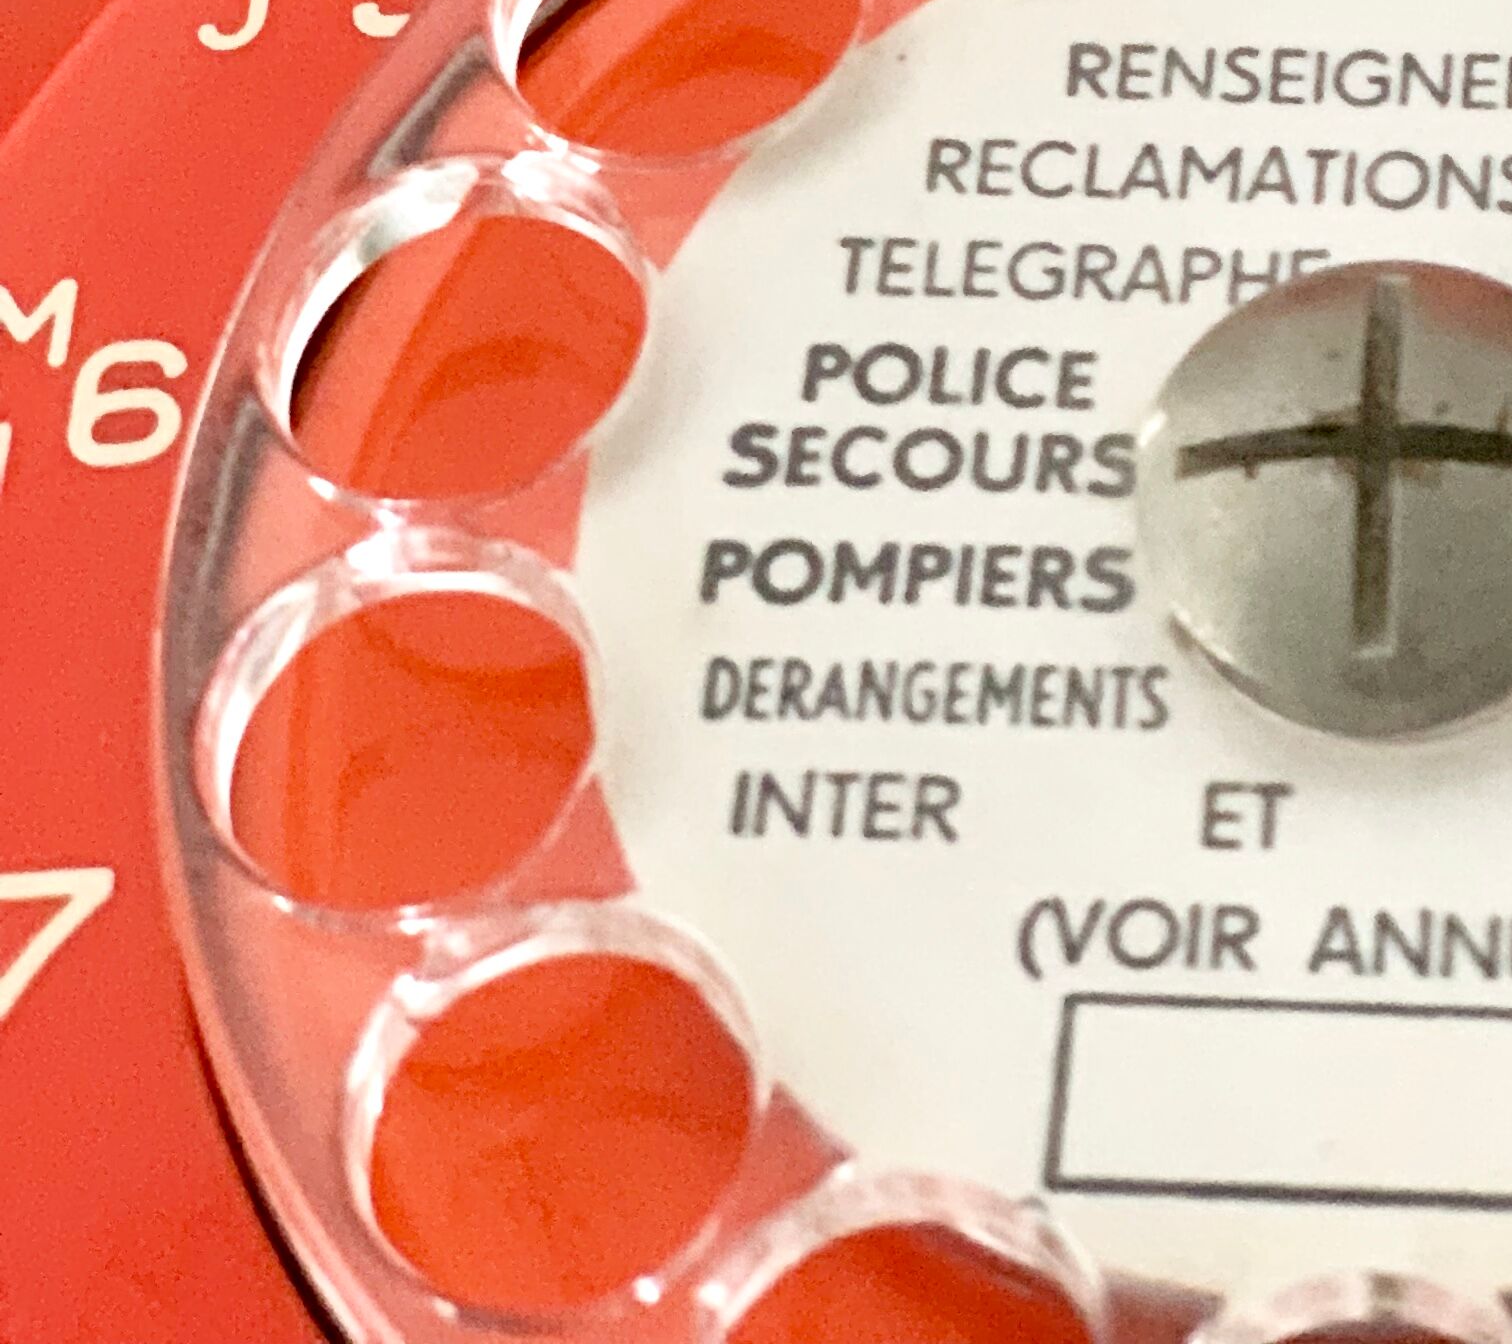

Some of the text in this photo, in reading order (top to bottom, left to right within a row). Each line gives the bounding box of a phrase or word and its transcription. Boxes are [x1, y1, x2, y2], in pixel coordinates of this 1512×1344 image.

[66, 338, 189, 468] 6
[801, 342, 1098, 411] POLICE
[722, 422, 1138, 499] SECOURS
[699, 538, 1136, 614] POMPIERS
[700, 655, 1170, 730] DERANGEMENTS
[730, 769, 962, 843] INTER
[1200, 780, 1295, 851] ET
[1016, 897, 1261, 981] (VOIR
